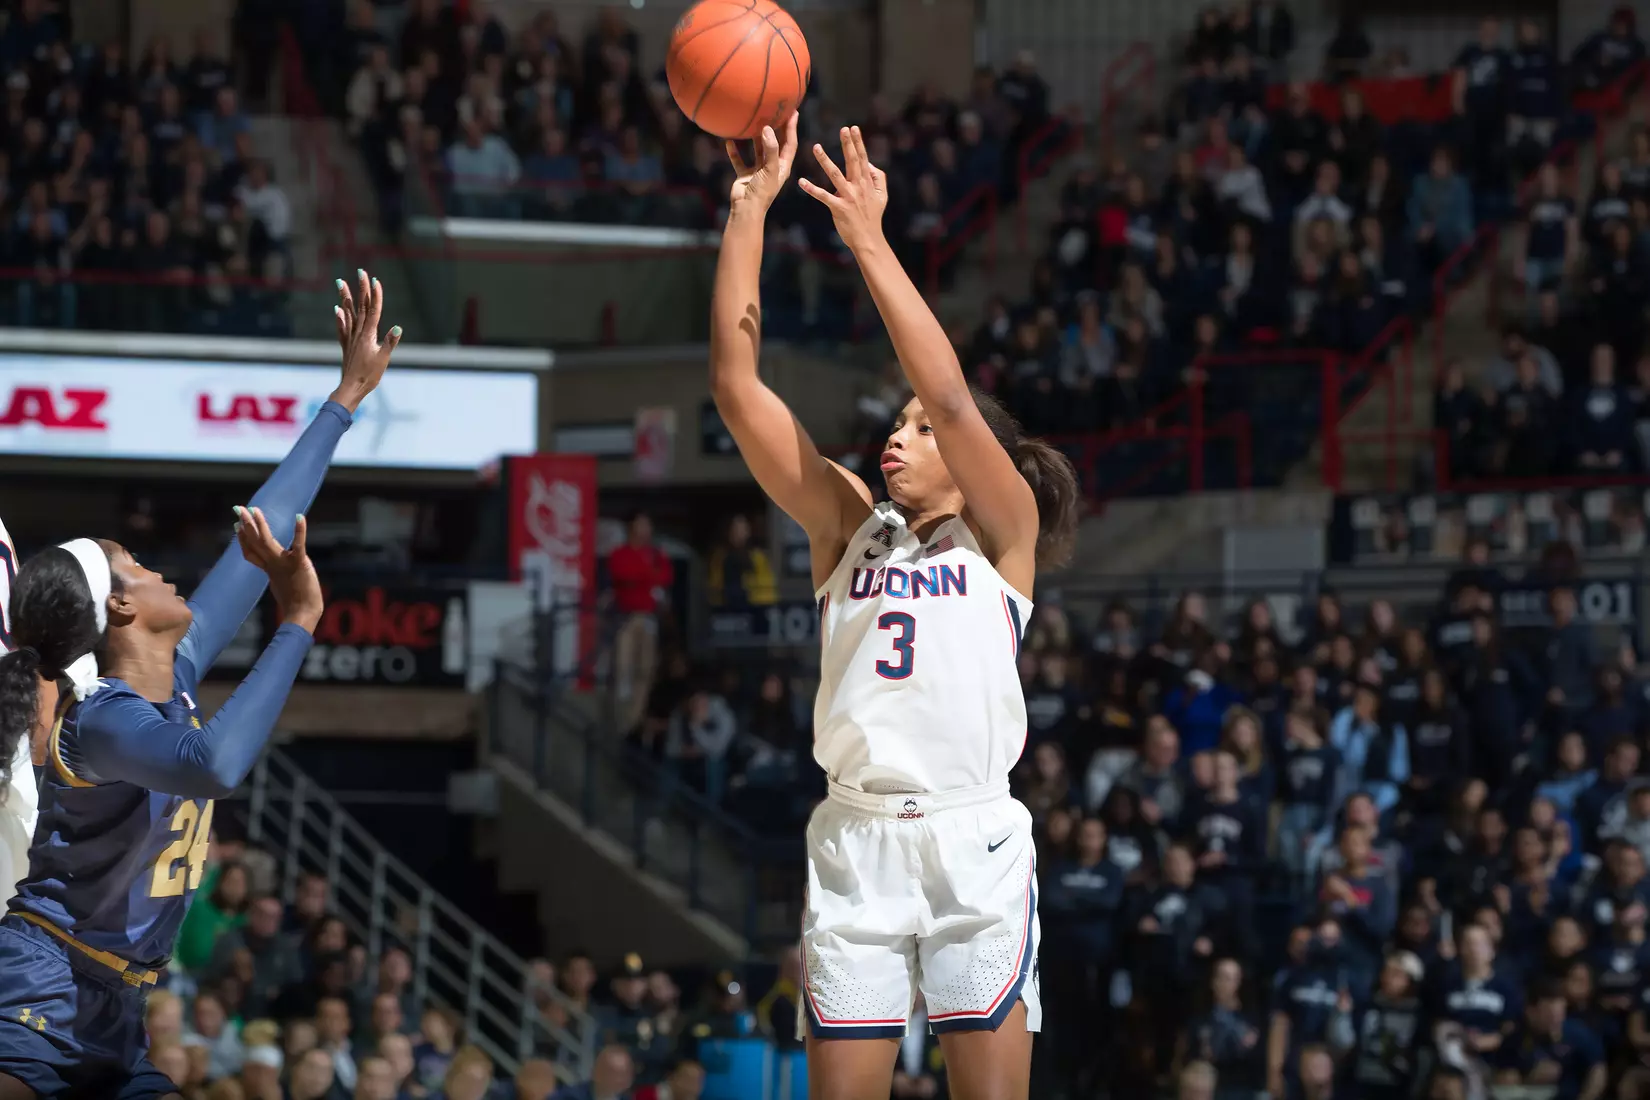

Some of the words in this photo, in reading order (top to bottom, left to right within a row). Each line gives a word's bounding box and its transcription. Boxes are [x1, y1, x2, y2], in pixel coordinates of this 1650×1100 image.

[0, 387, 107, 429] AZ
[197, 394, 298, 424] LAZ
[849, 564, 967, 600] UCONN
[1575, 582, 1632, 621] 01
[275, 586, 441, 647] oke
[302, 644, 417, 682] zero
[875, 611, 916, 680] 3
[150, 799, 215, 897] 24
